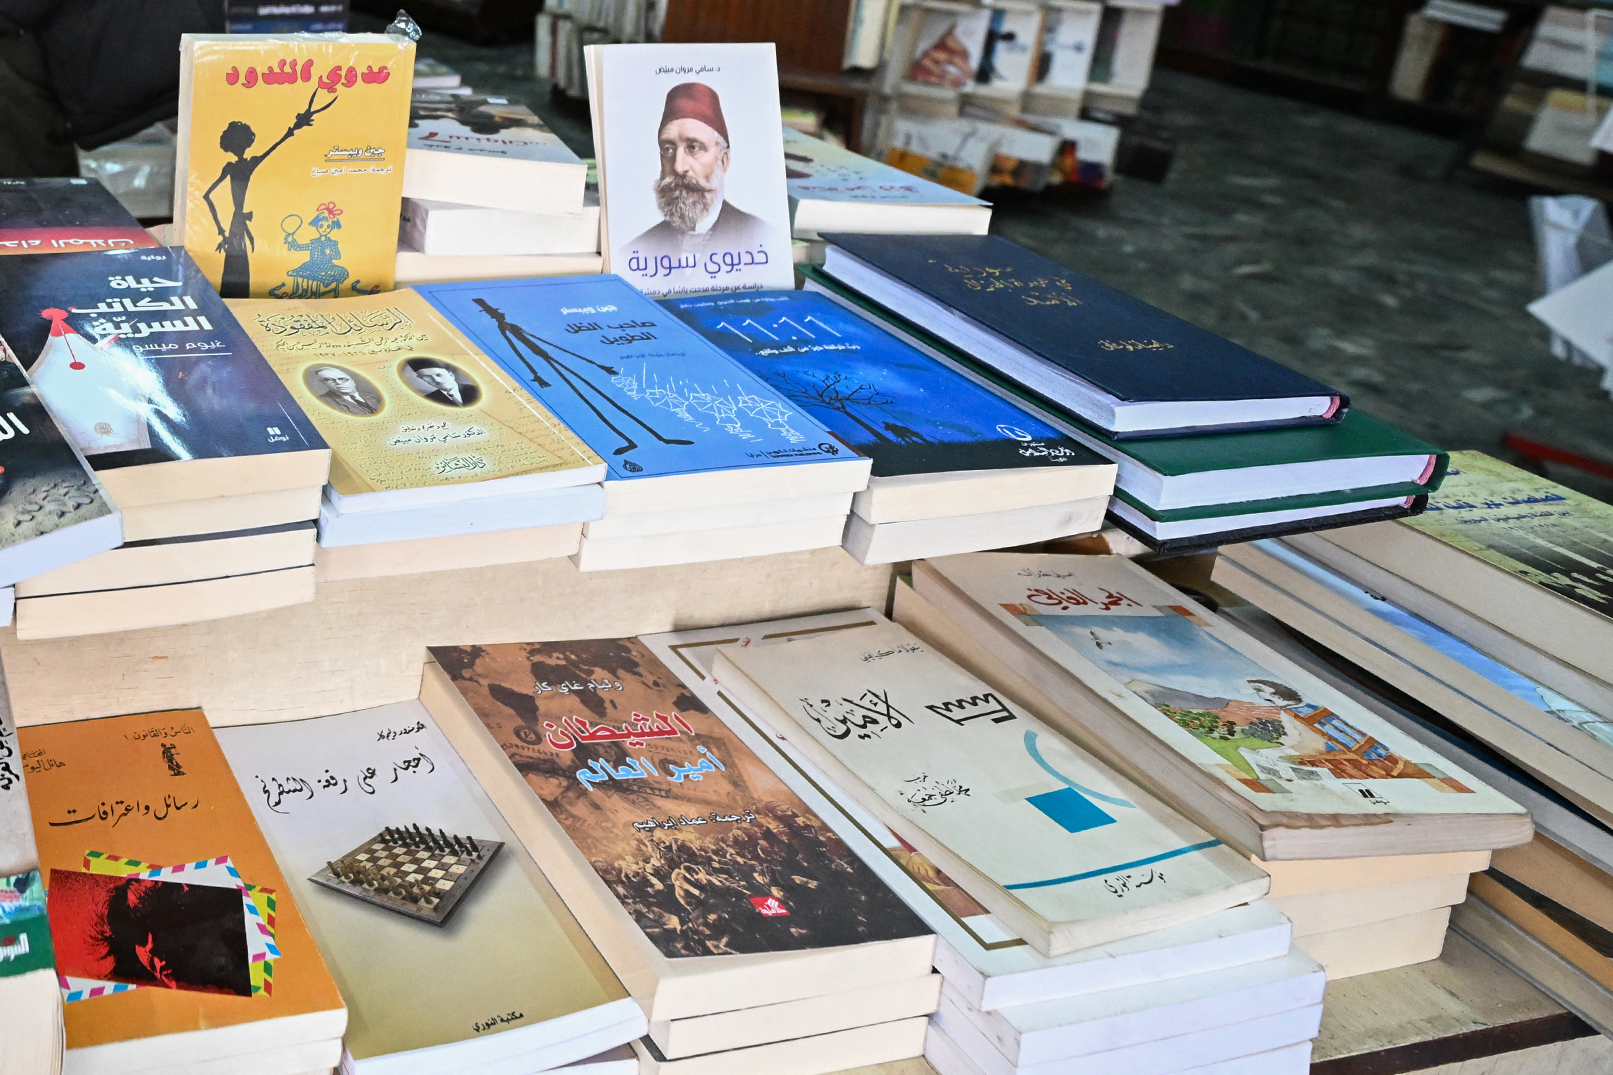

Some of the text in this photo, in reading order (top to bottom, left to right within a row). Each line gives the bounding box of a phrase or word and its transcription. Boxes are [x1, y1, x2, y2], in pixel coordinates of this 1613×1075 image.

[225, 58, 390, 93] عدوي اللدود
[324, 145, 385, 160] جين ويبستر
[348, 166, 367, 174] محمد
[51, 237, 135, 249] الملاك
[140, 253, 166, 261] رواية
[628, 244, 769, 279] خديوي سورية
[109, 275, 183, 291] حياة
[689, 284, 710, 295] مدحت
[711, 283, 729, 293] مرحلة
[639, 286, 661, 297] دمش
[73, 295, 198, 318] الكاتب
[564, 319, 658, 334] صاحب الظل
[132, 340, 226, 352] غيوم ميسو
[600, 331, 658, 346] الطويل
[533, 679, 624, 694] وليام غاي كار
[542, 710, 696, 752] الشيطان
[576, 746, 726, 790] أمير العالم
[358, 766, 376, 795] على
[48, 792, 200, 829] رسائل واعترافات
[679, 813, 707, 826] عماد
[472, 1010, 525, 1034] مكتبة النوري
